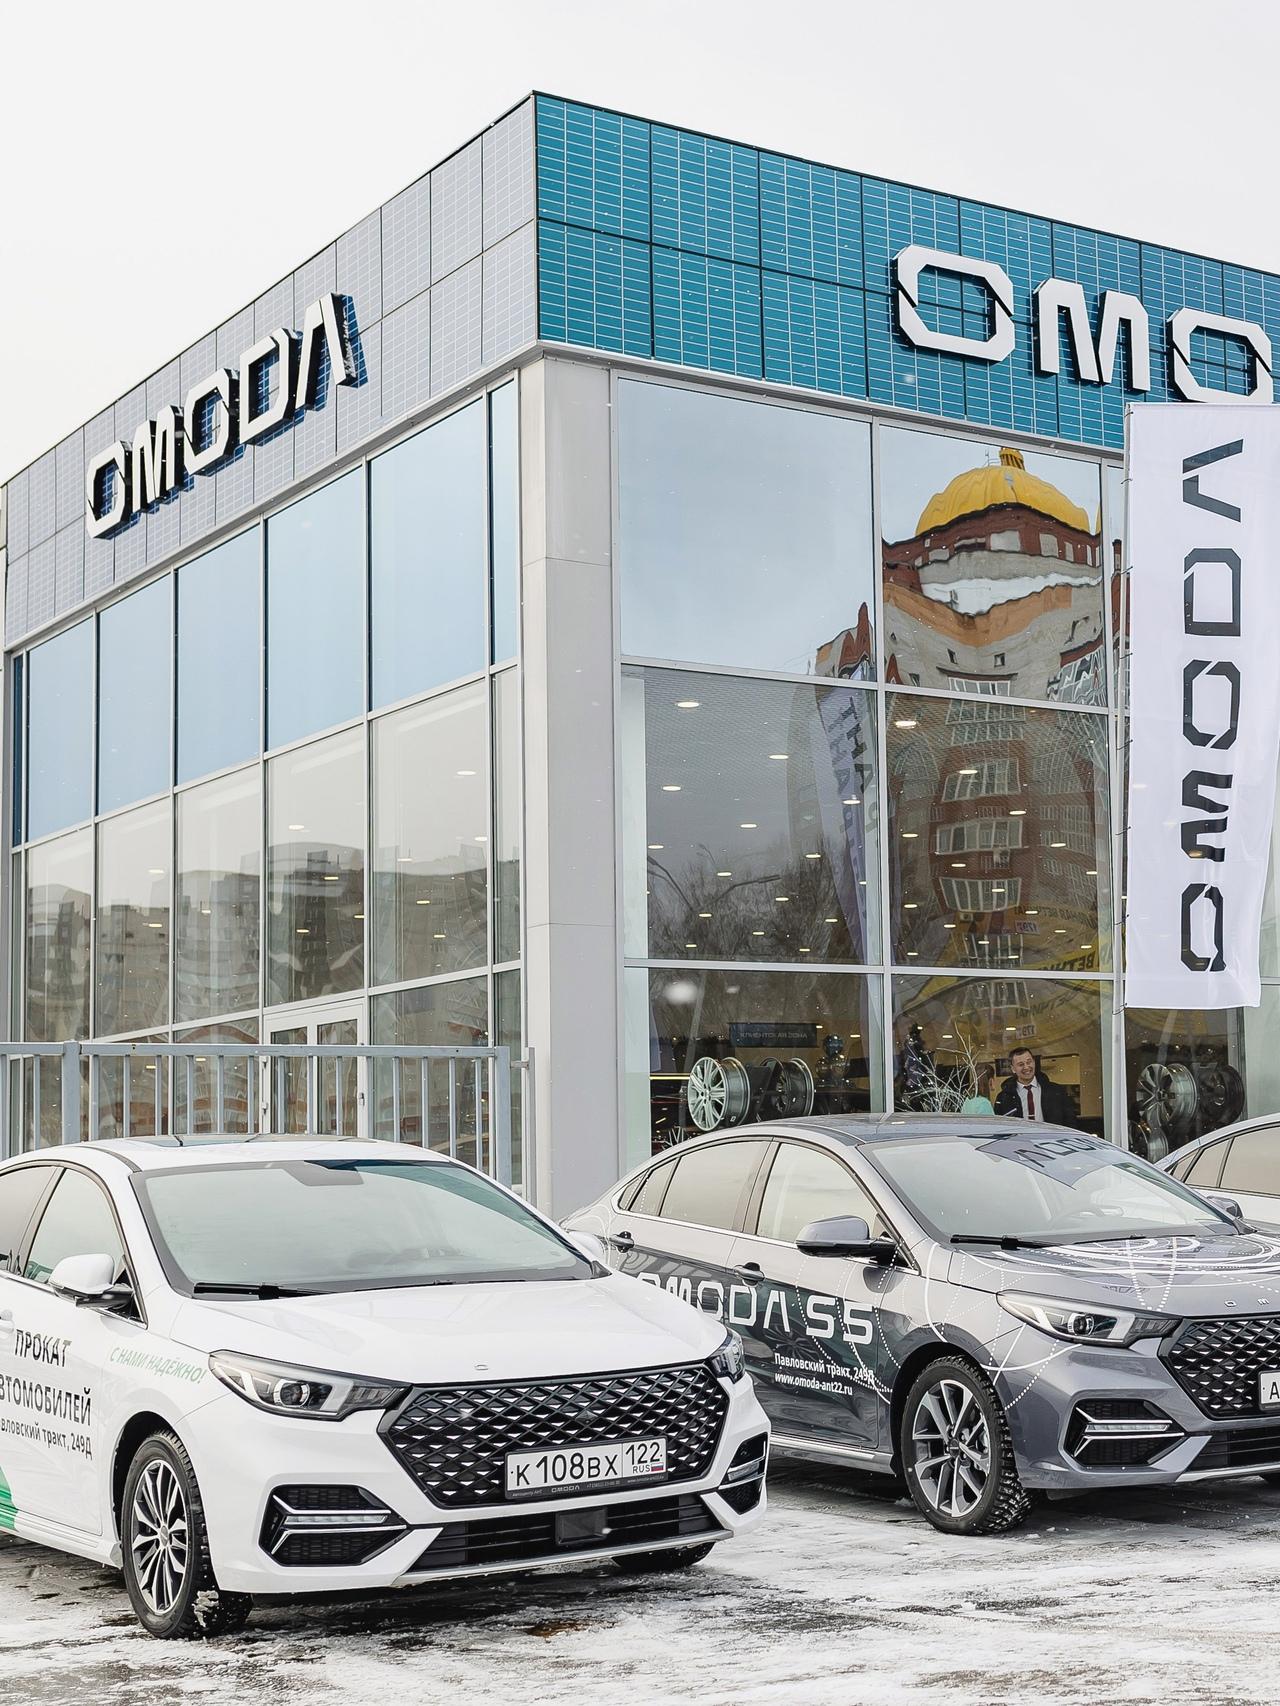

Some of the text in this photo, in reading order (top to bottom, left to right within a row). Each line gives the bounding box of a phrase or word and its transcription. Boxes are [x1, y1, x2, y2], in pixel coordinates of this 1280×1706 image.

[86, 292, 358, 538] OMODA
[1180, 438, 1245, 973] OMODA
[15, 1329, 72, 1367] ПРОКАТ
[774, 1352, 825, 1373] Павловский
[774, 1373, 853, 1396] www.omoda-ant22.ru
[71, 1432, 93, 1460] 249Д
[516, 1442, 660, 1487] К108ВХ 122
[632, 1464, 651, 1474] RUS
